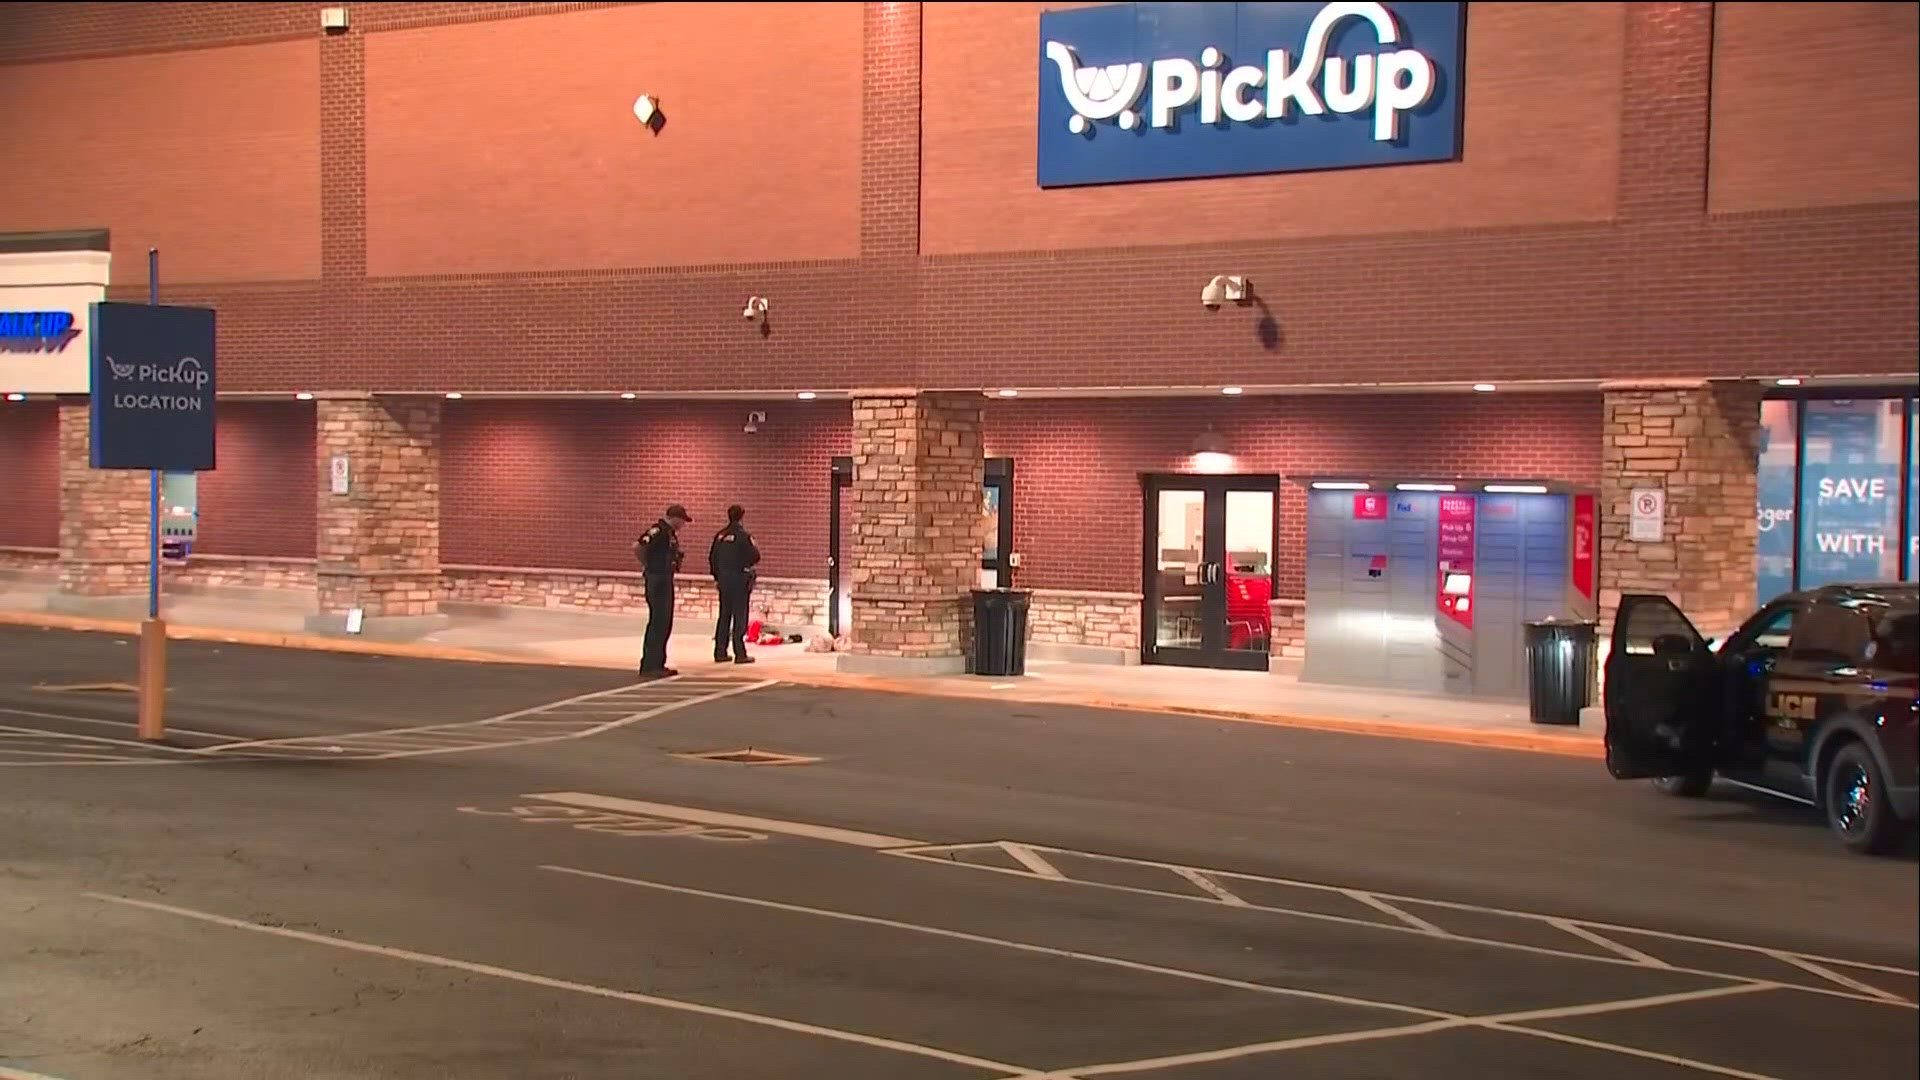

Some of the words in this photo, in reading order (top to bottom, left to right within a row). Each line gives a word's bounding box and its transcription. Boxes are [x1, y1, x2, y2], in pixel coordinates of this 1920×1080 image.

[40, 312, 70, 337] UP
[114, 394, 201, 411] LOCATION
[1819, 477, 1885, 498] SAVE
[1816, 533, 1884, 554] WITH
